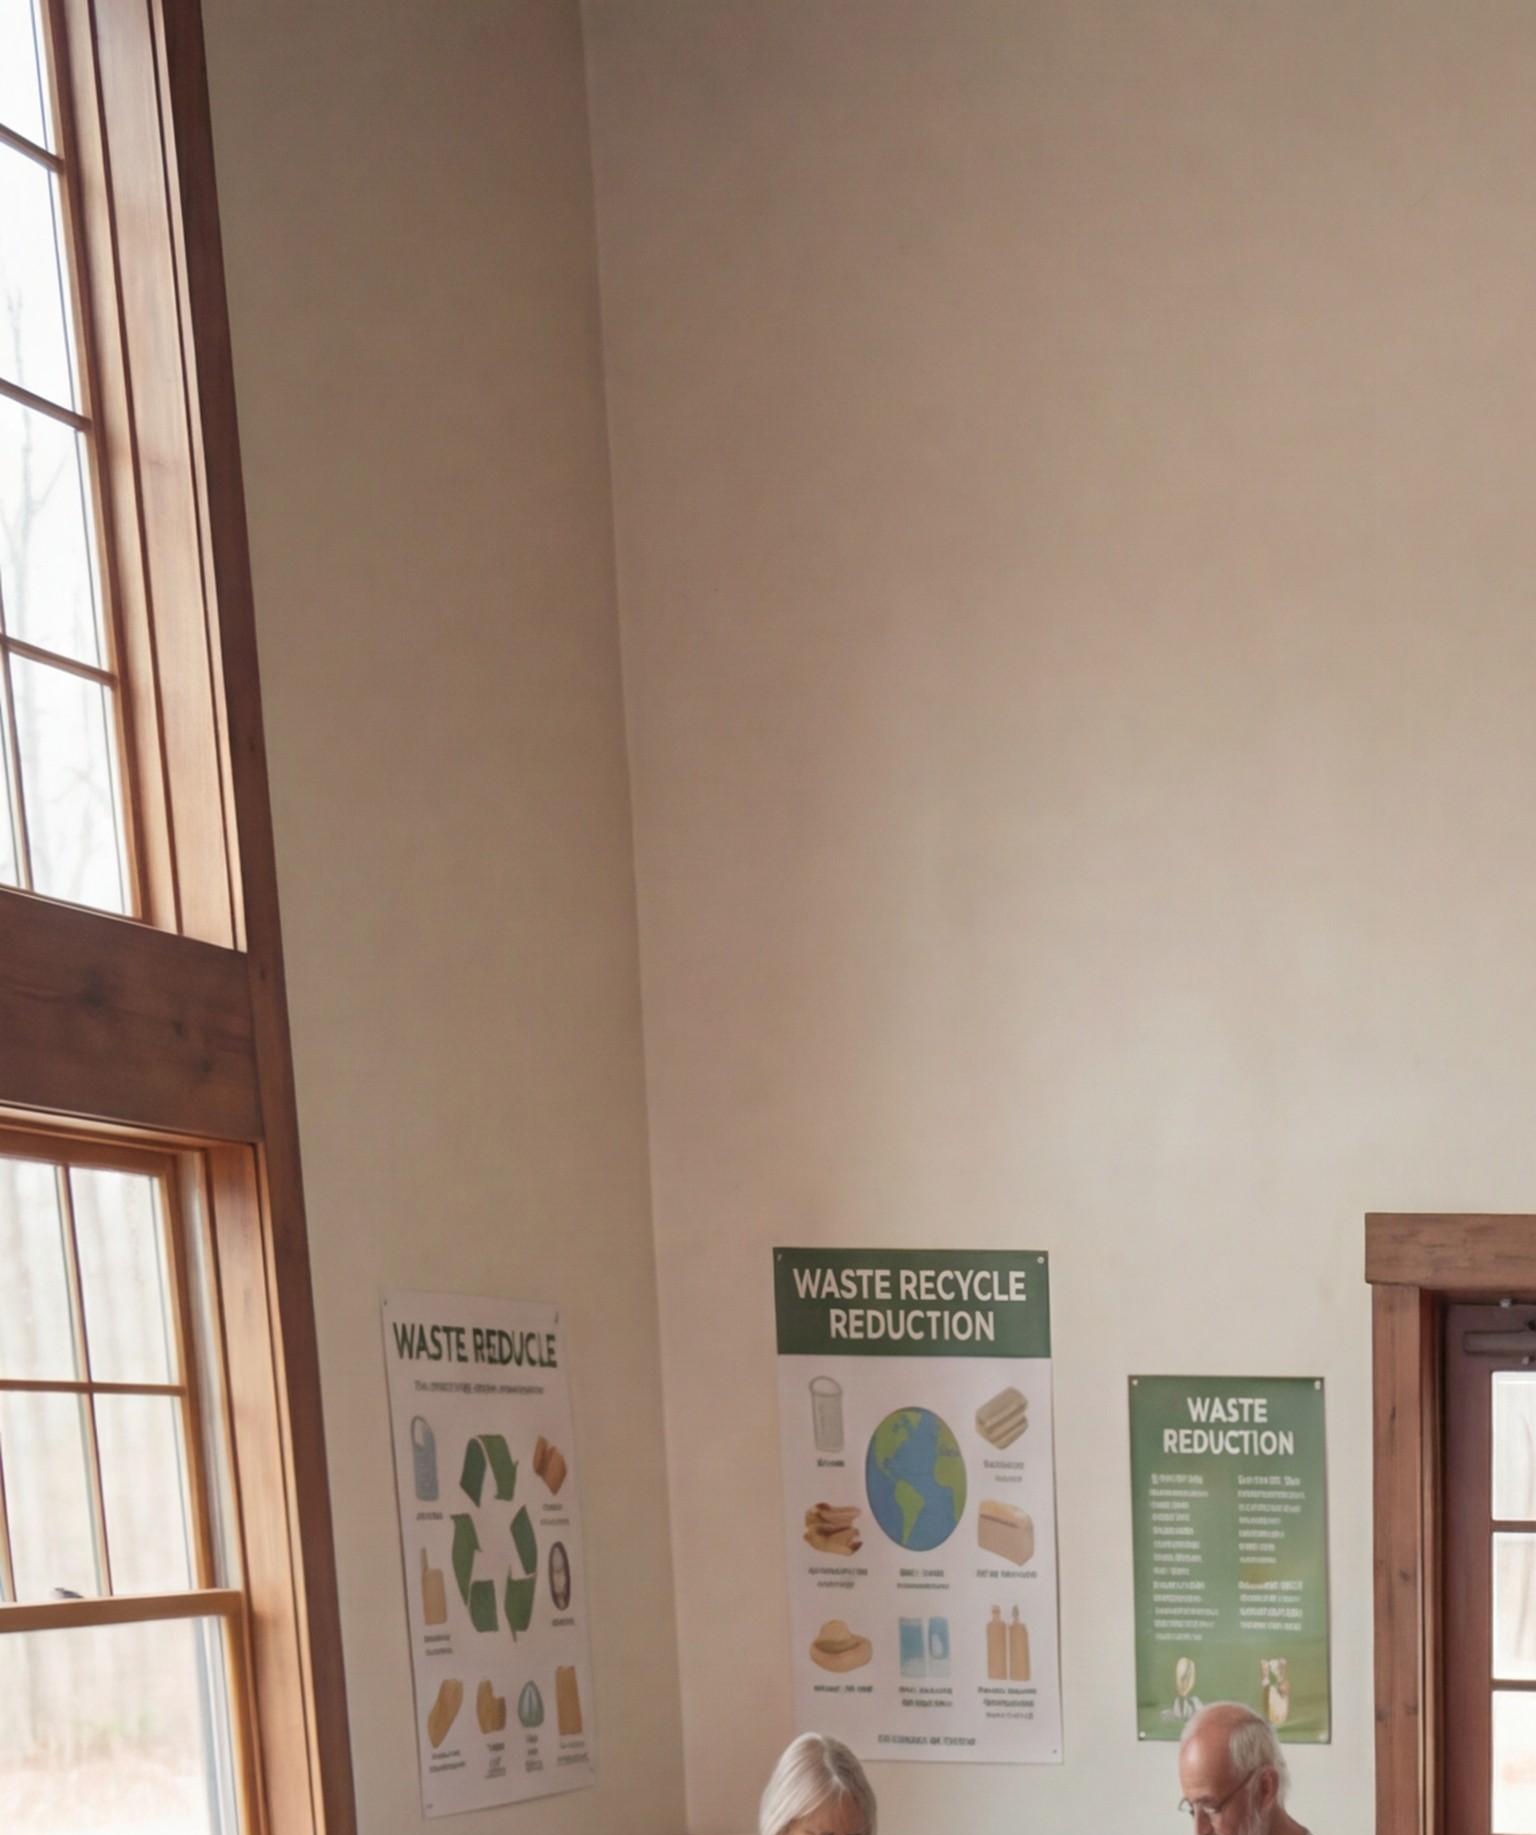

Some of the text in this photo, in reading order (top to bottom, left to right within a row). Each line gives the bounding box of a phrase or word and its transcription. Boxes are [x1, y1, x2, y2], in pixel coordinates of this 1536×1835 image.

[793, 1268, 1027, 1302] WASTE RECYCLE
[829, 1308, 995, 1342] REDUCTION
[392, 1321, 469, 1364] WASTE
[1186, 1396, 1268, 1423] WASTE
[1163, 1428, 1295, 1456] REDUCTION
